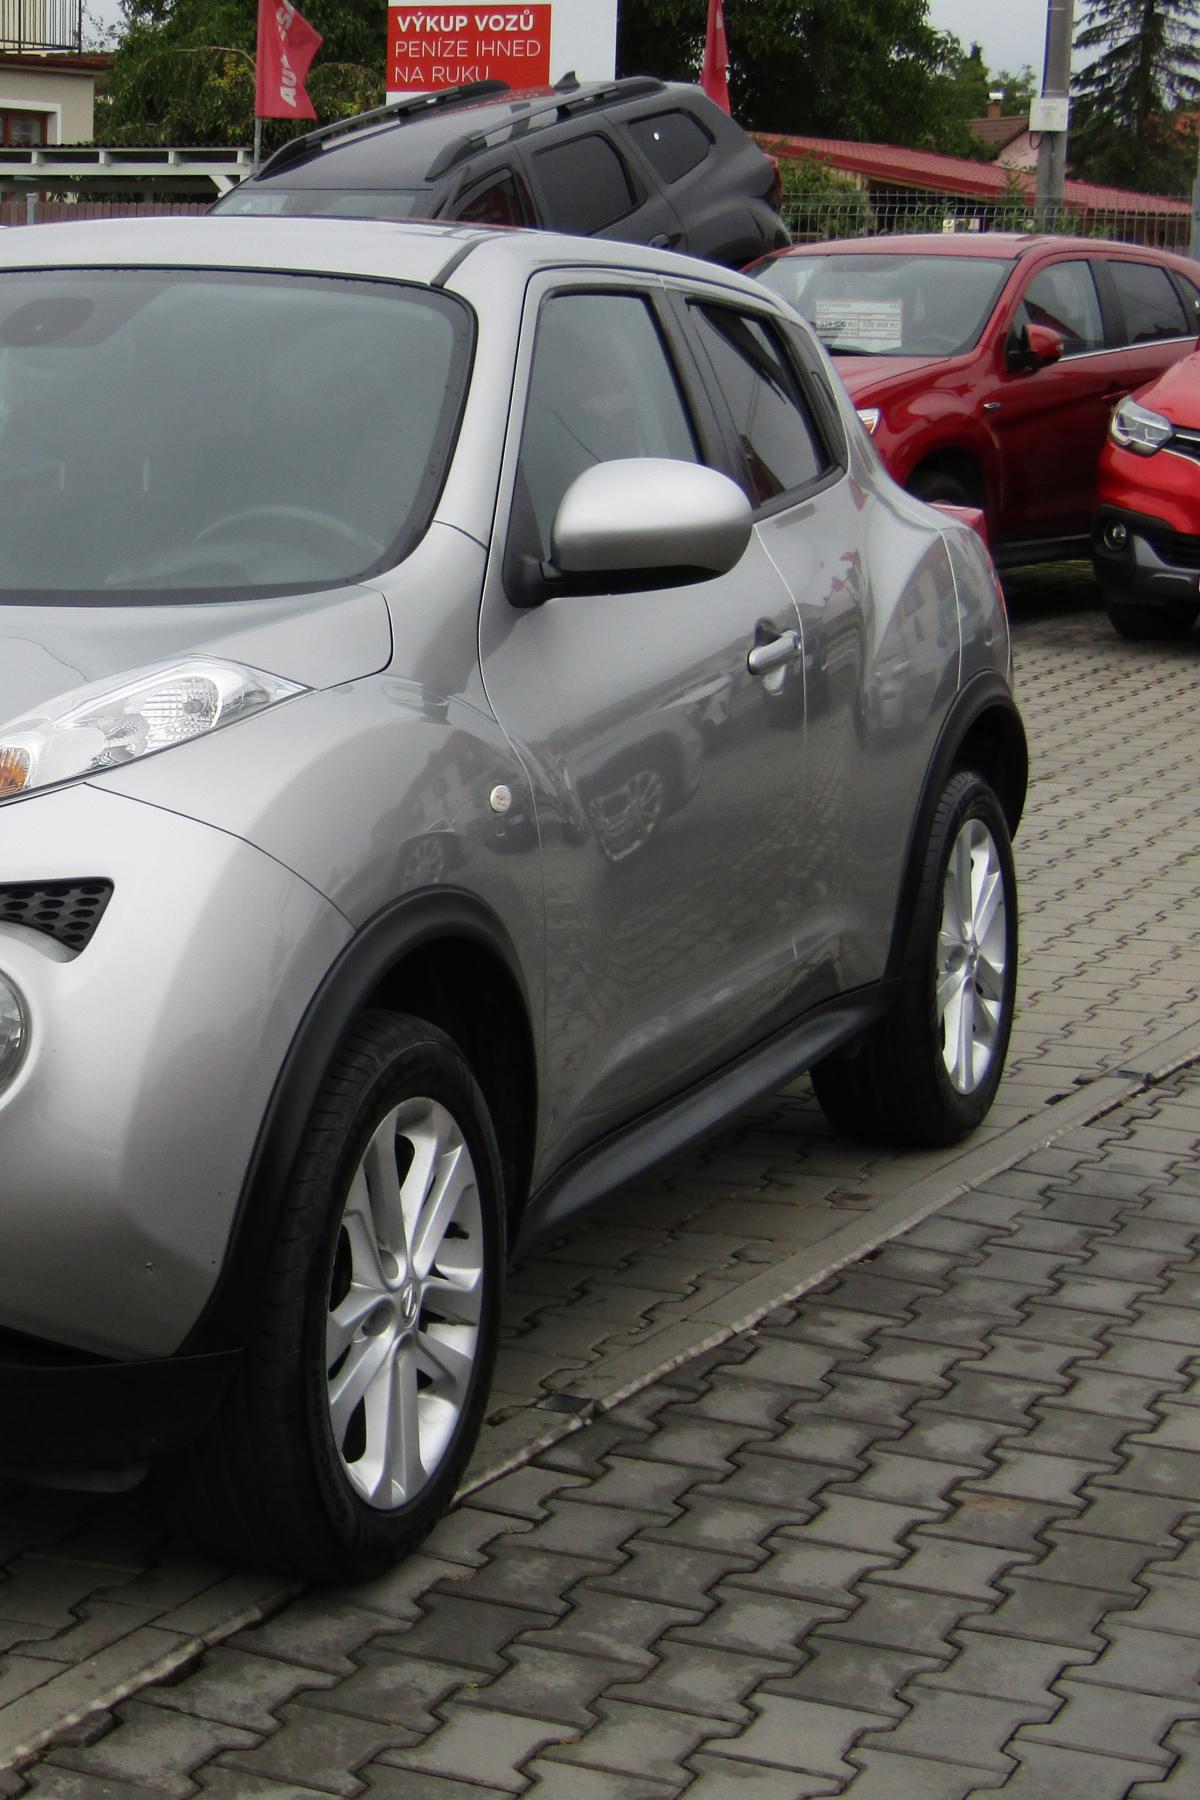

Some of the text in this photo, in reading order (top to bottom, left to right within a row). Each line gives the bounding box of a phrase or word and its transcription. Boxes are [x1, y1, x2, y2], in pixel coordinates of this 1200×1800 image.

[397, 9, 534, 32] VÝKUP VOZŮ
[395, 37, 541, 58] PENÍZE IHNED
[395, 66, 489, 83] NA RUKU
